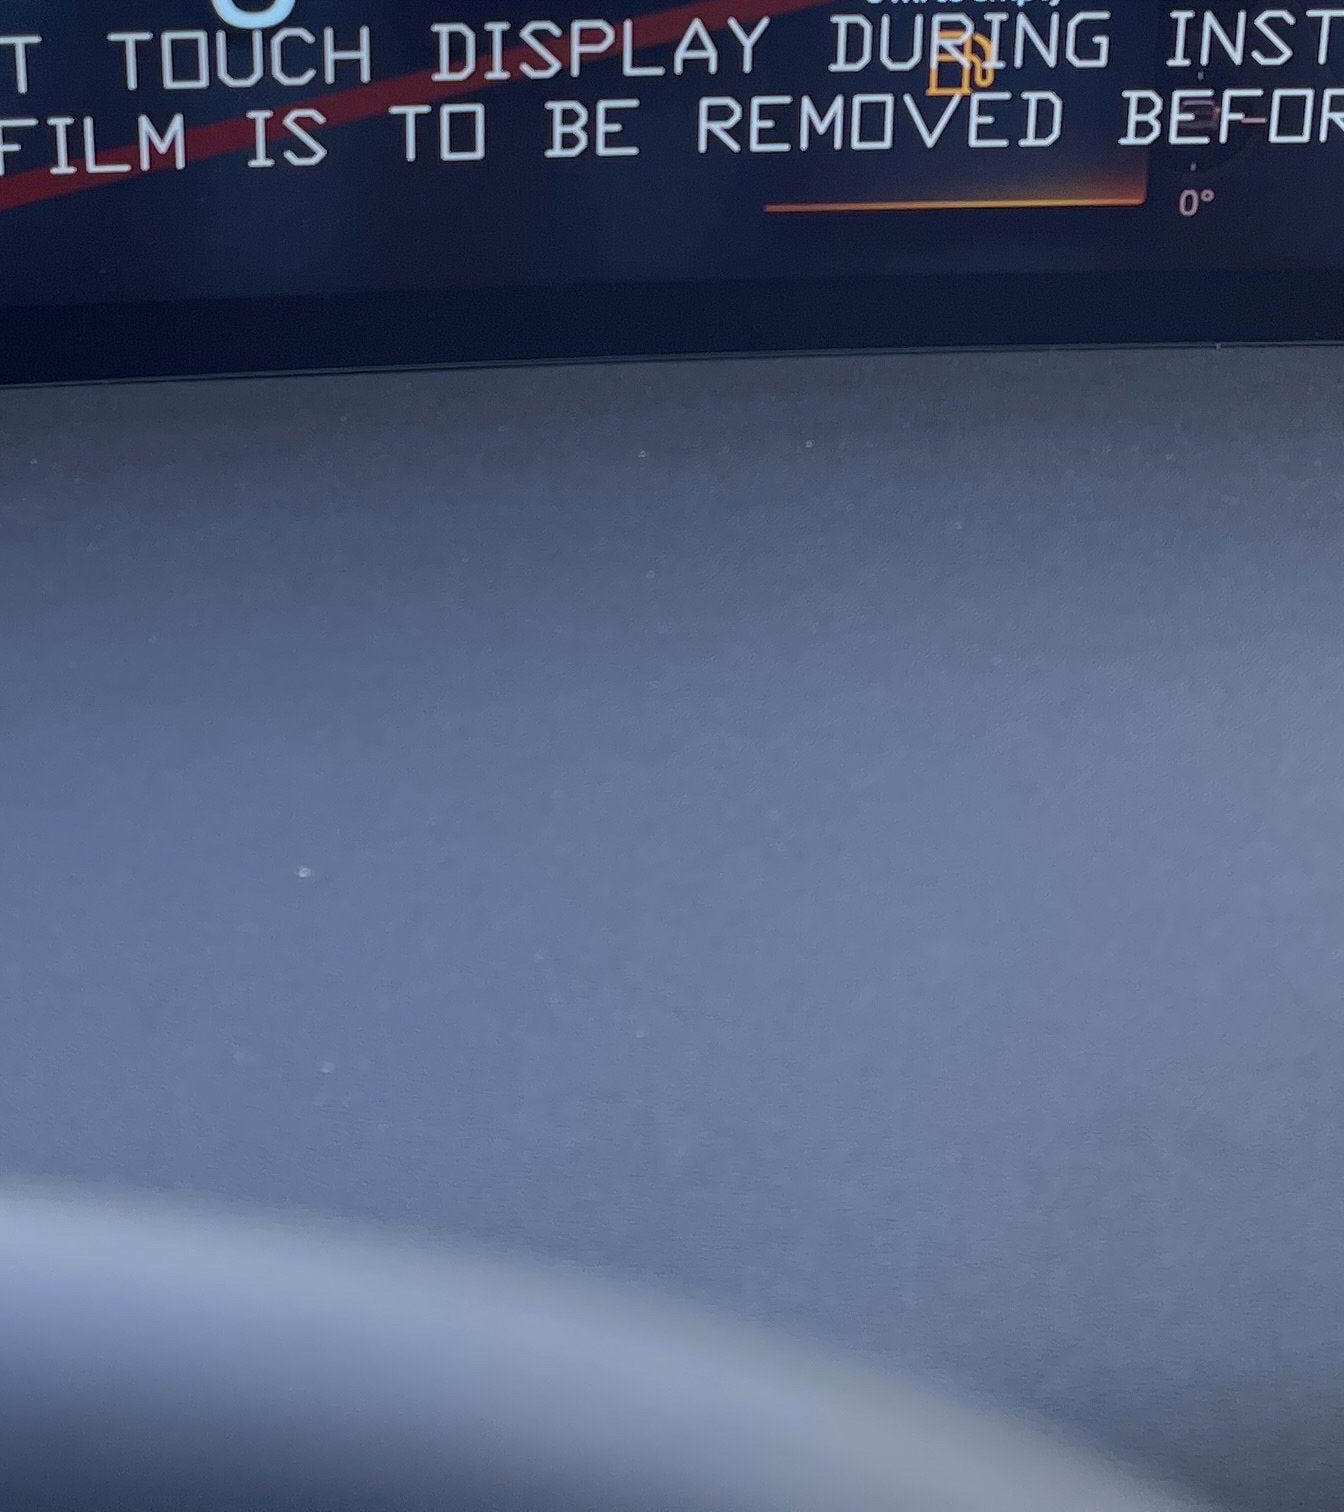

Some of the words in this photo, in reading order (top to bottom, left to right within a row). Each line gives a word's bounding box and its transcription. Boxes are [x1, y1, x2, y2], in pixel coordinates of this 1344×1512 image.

[107, 25, 371, 90] TOUCH
[430, 16, 771, 82] DISPLAY
[828, 11, 1111, 73] DURING
[247, 108, 328, 169] IS
[388, 102, 486, 161] TO
[544, 98, 641, 158] BE
[697, 90, 1063, 154] REMOVED
[1178, 188, 1216, 217] 0°
